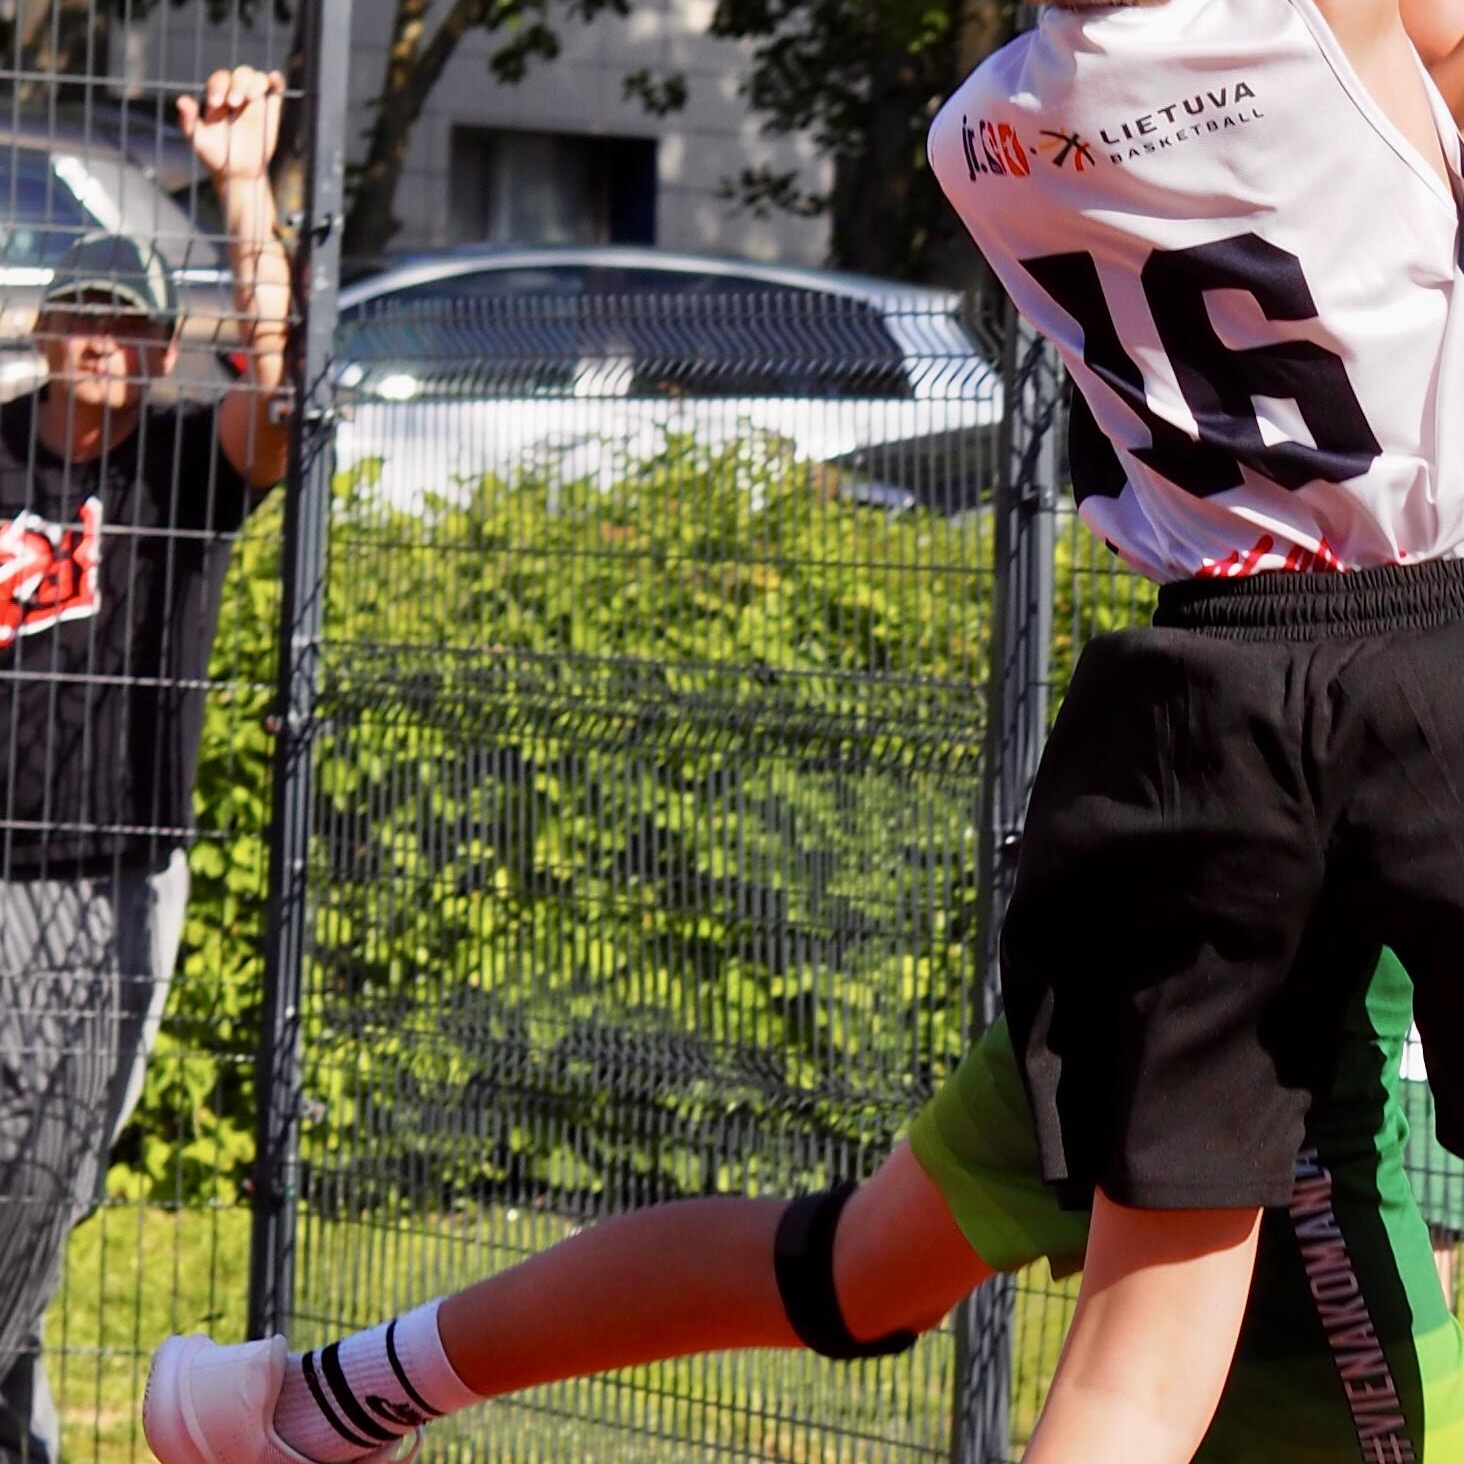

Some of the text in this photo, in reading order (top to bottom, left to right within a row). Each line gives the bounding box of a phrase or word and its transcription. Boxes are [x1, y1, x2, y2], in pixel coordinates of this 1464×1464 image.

[1100, 80, 1257, 145] LIETUVA
[1110, 107, 1265, 165] BASKETBALL
[1018, 232, 1384, 500] 16
